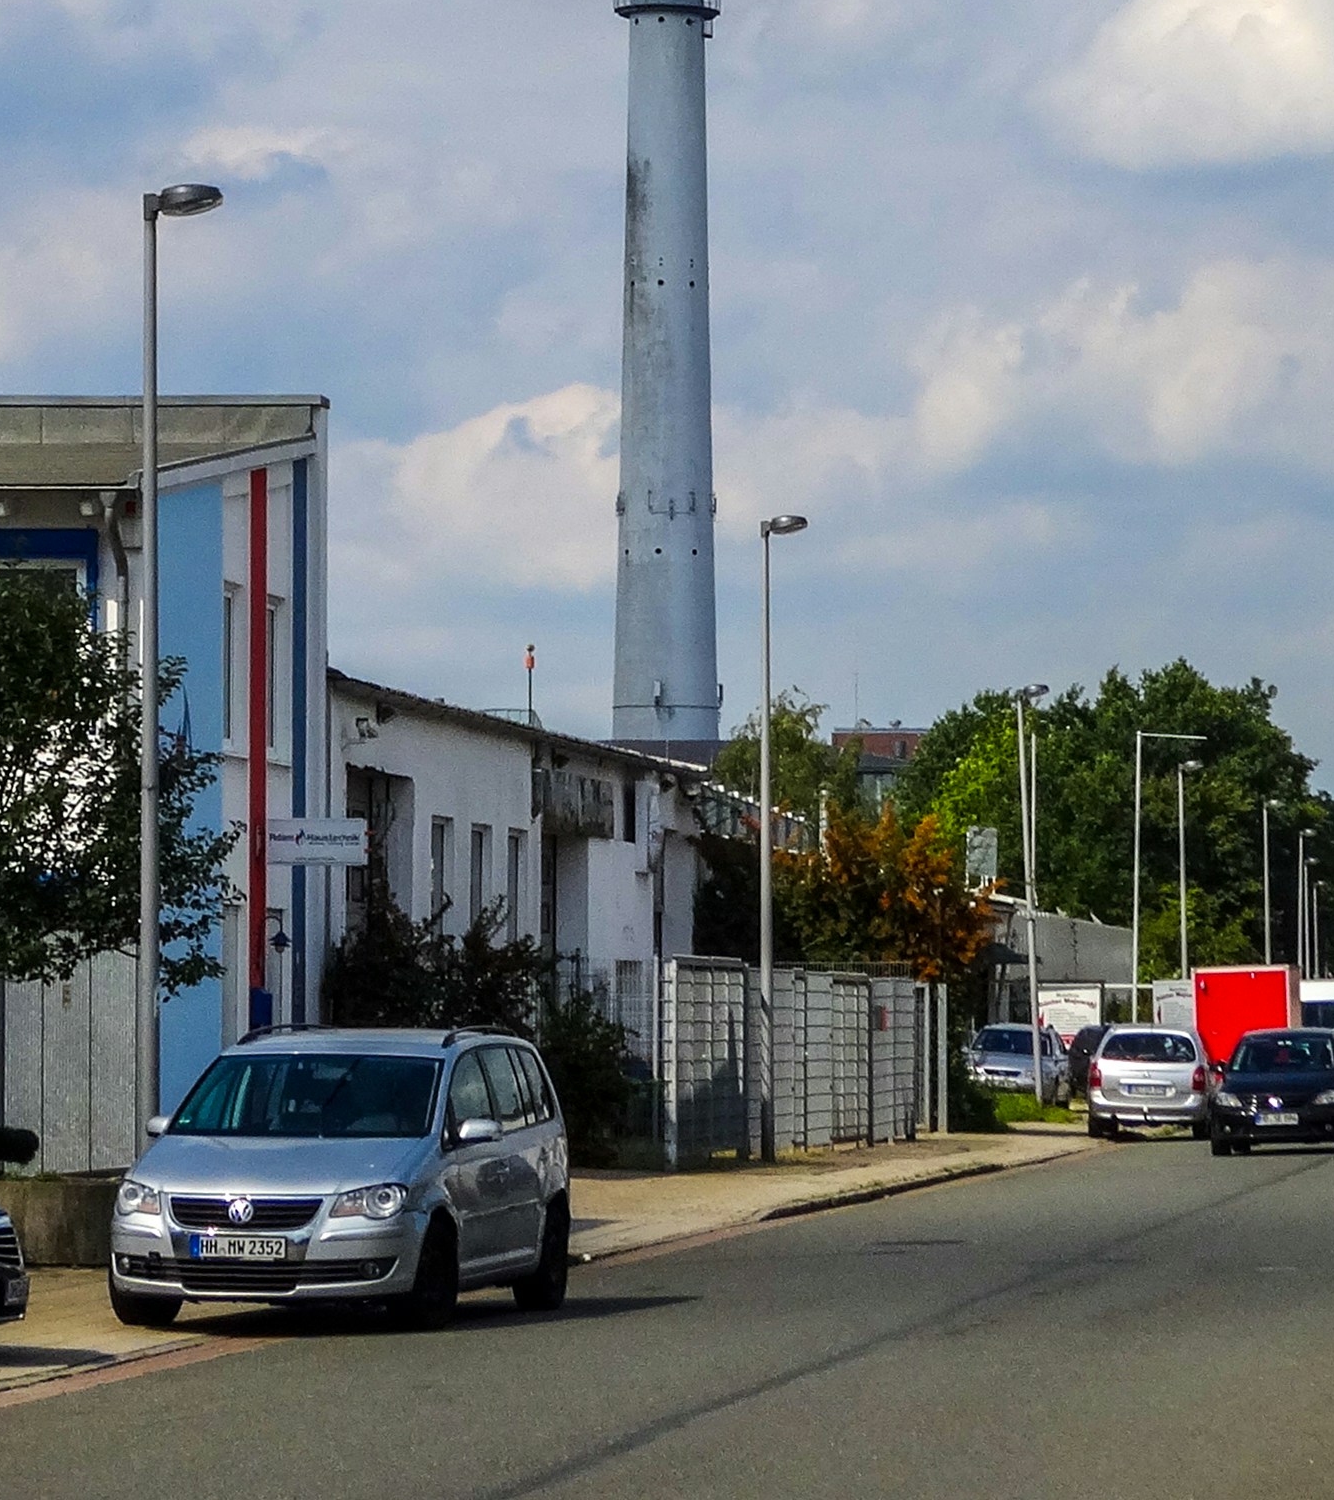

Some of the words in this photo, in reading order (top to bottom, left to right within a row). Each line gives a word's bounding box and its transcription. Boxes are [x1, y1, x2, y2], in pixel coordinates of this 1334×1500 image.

[306, 833, 360, 841] Haustechnik
[200, 1239, 218, 1254] HH
[228, 1240, 245, 1255] MW
[248, 1240, 283, 1256] 2352
